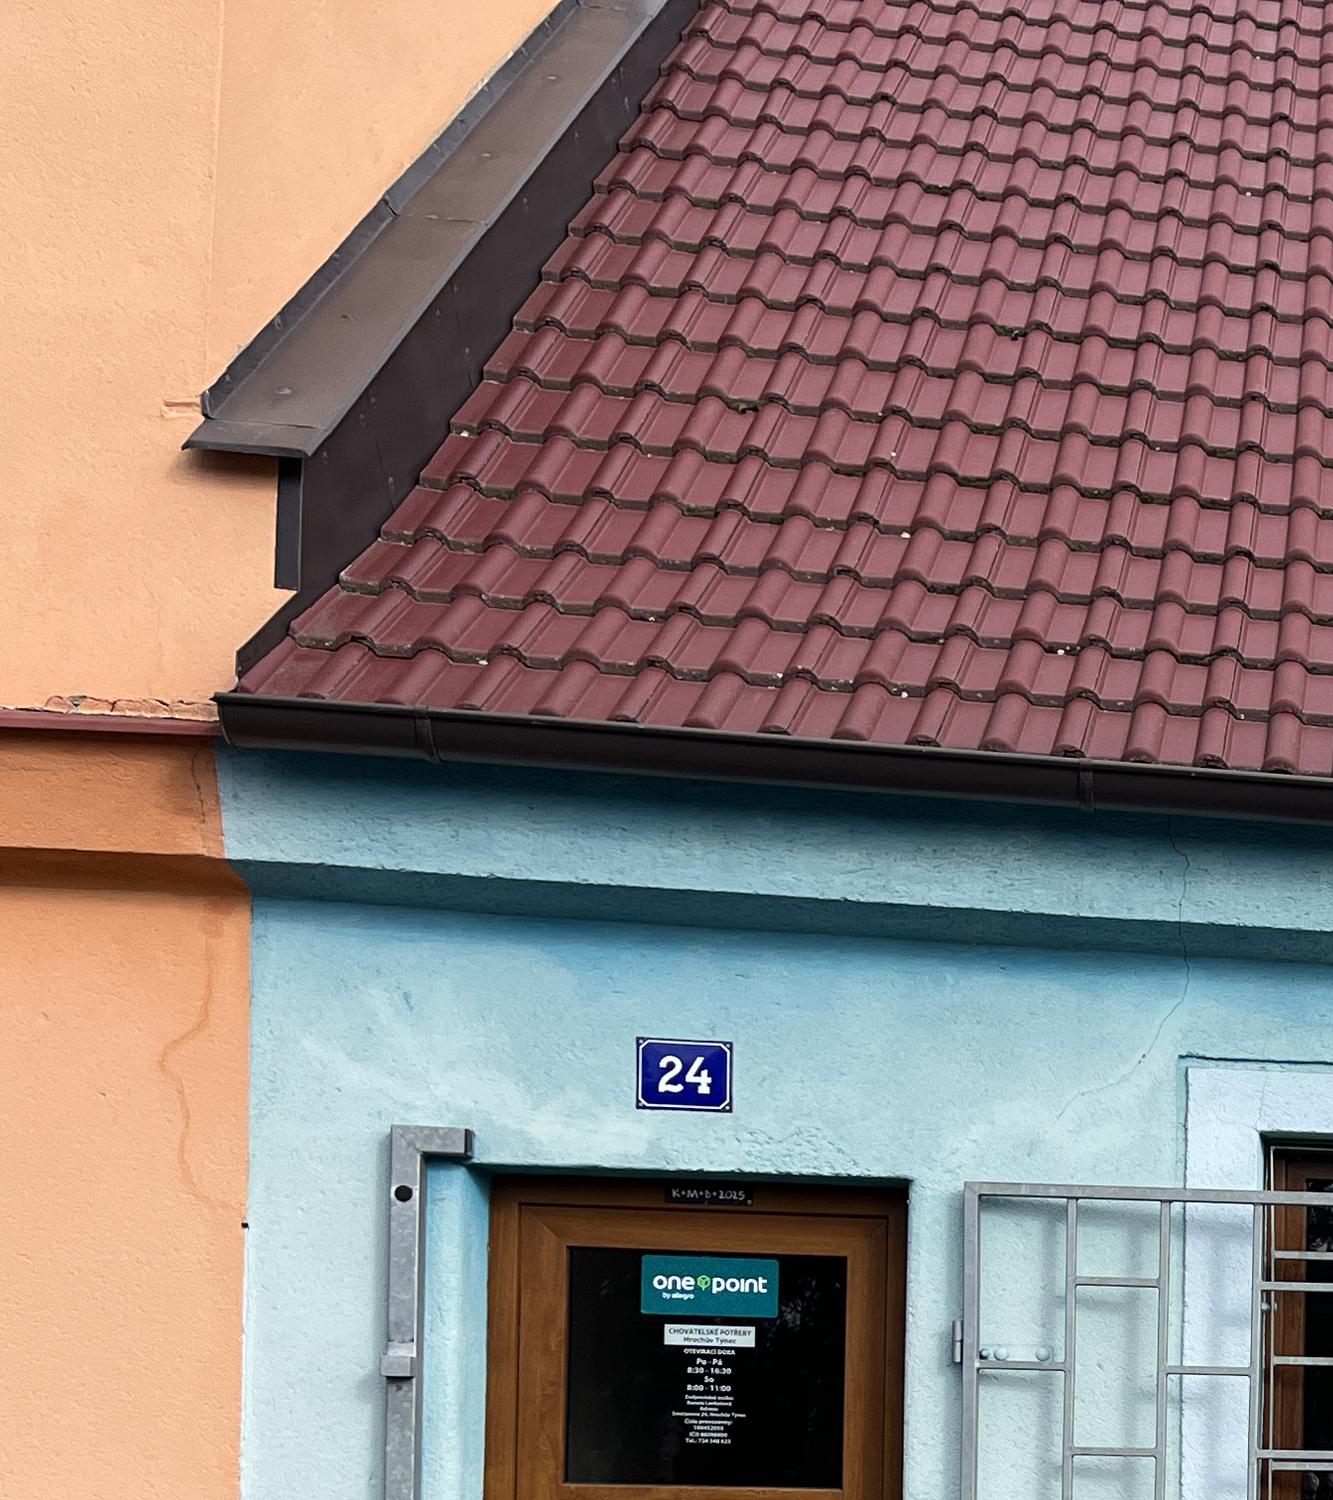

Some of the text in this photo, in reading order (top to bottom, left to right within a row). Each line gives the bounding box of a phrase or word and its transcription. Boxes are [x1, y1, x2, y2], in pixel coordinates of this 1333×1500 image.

[658, 1055, 712, 1094] 24
[652, 1275, 768, 1294] one point
